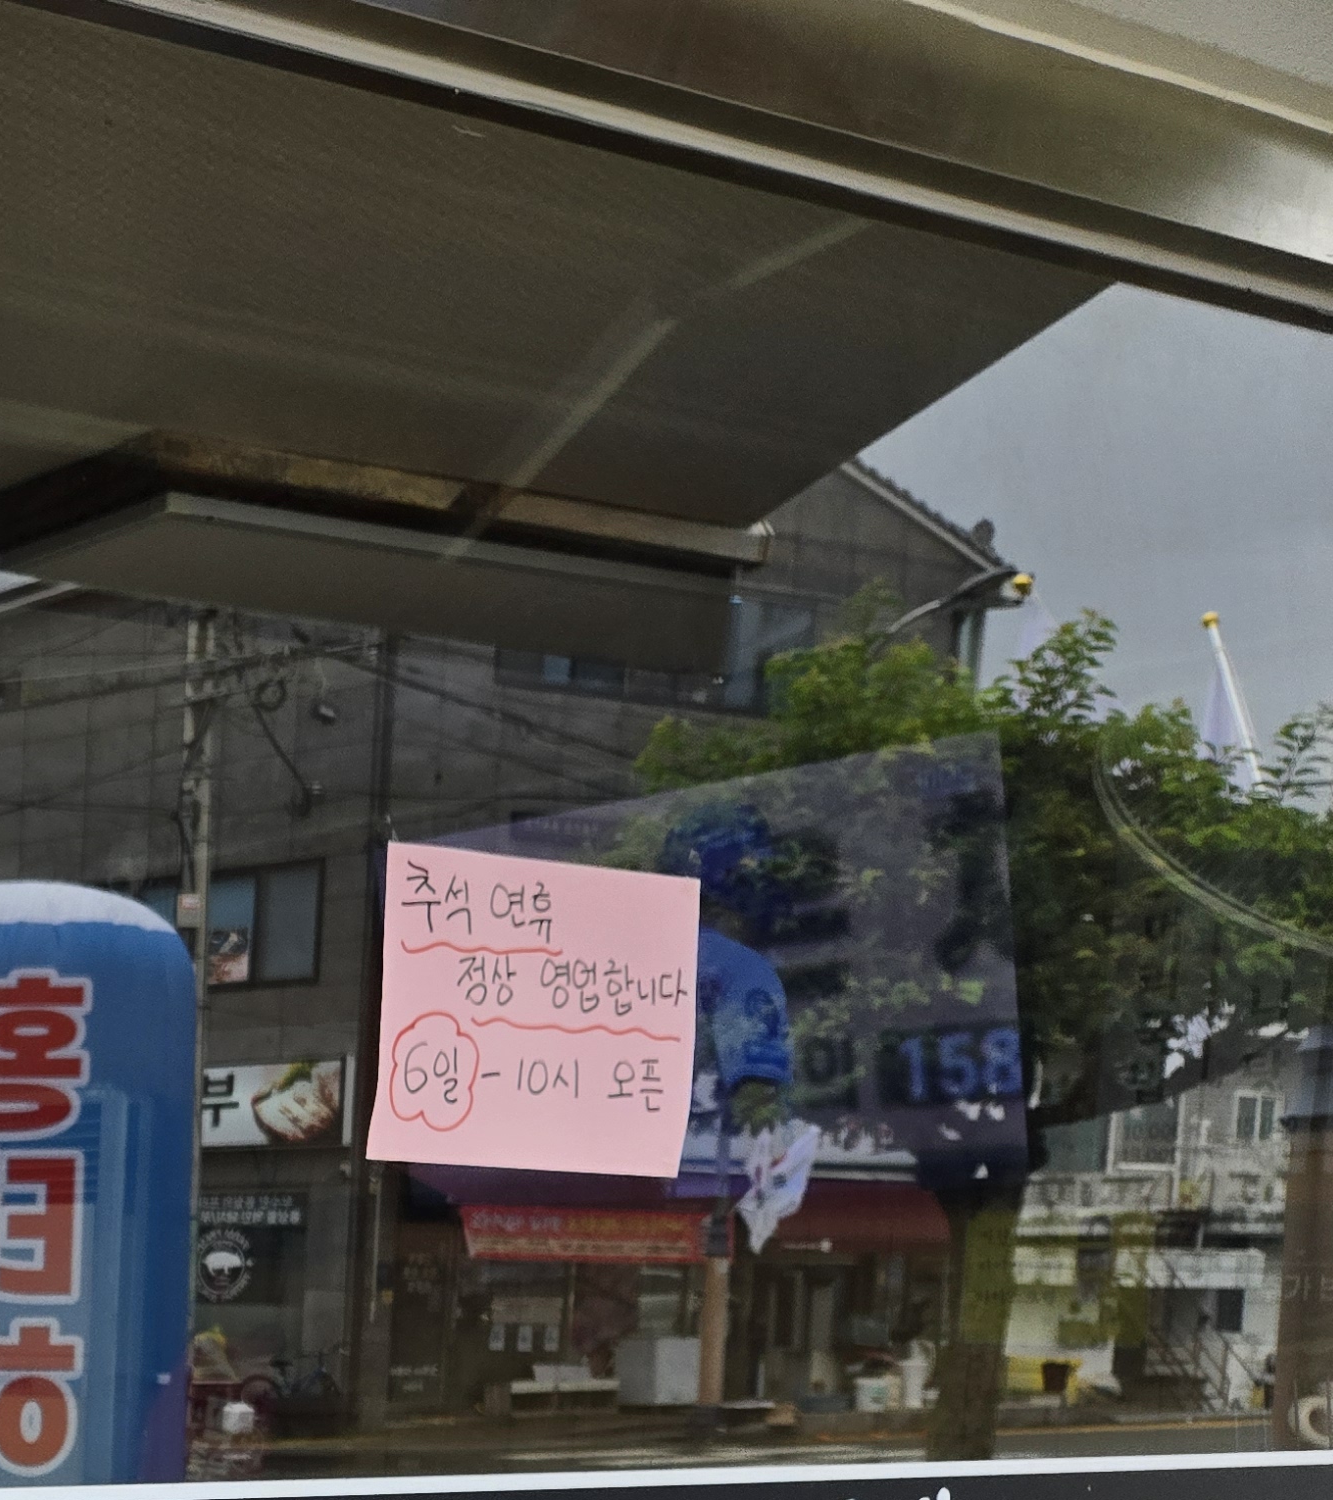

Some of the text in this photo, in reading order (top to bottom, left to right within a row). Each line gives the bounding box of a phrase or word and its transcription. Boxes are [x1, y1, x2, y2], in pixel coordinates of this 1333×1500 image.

[401, 860, 553, 944] 추석 연휴
[456, 955, 688, 1016] 정상 영업합니다
[404, 1042, 459, 1105] 6일
[517, 1058, 579, 1099] 10시
[607, 1058, 664, 1113] 오픈
